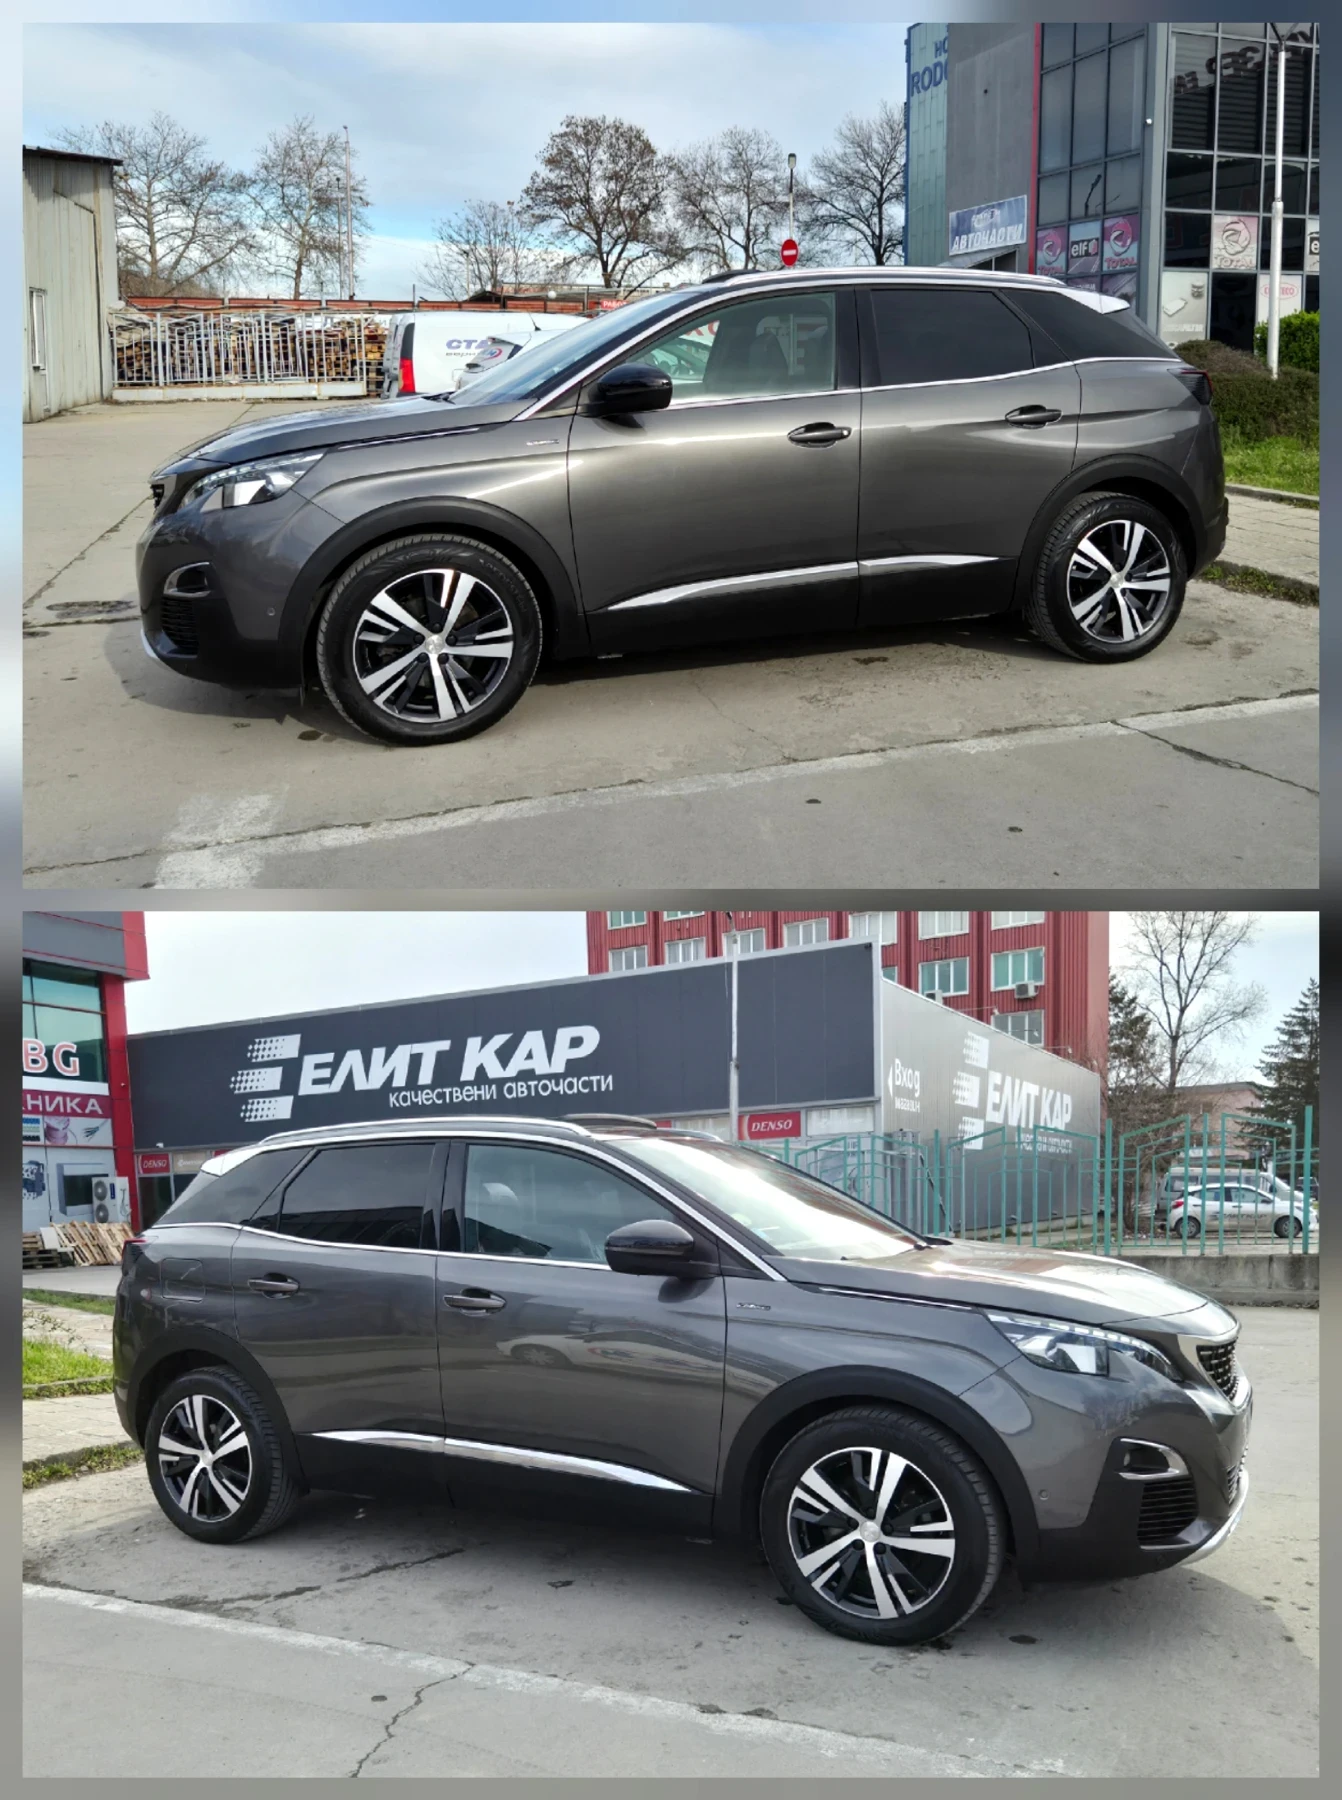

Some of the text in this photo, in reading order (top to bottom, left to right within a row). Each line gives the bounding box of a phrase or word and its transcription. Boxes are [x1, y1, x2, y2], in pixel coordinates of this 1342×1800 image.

[1071, 241, 1088, 257] elf
[1105, 256, 1137, 269] TOTAL
[23, 1038, 80, 1077] BG
[298, 1025, 601, 1096] ЕЛИТ КАР
[389, 1074, 613, 1108] качествени авточасти
[986, 1070, 1073, 1133] ЕЛИТ КАР
[751, 1119, 793, 1132] DENSO
[143, 1159, 167, 1169] DENSO
